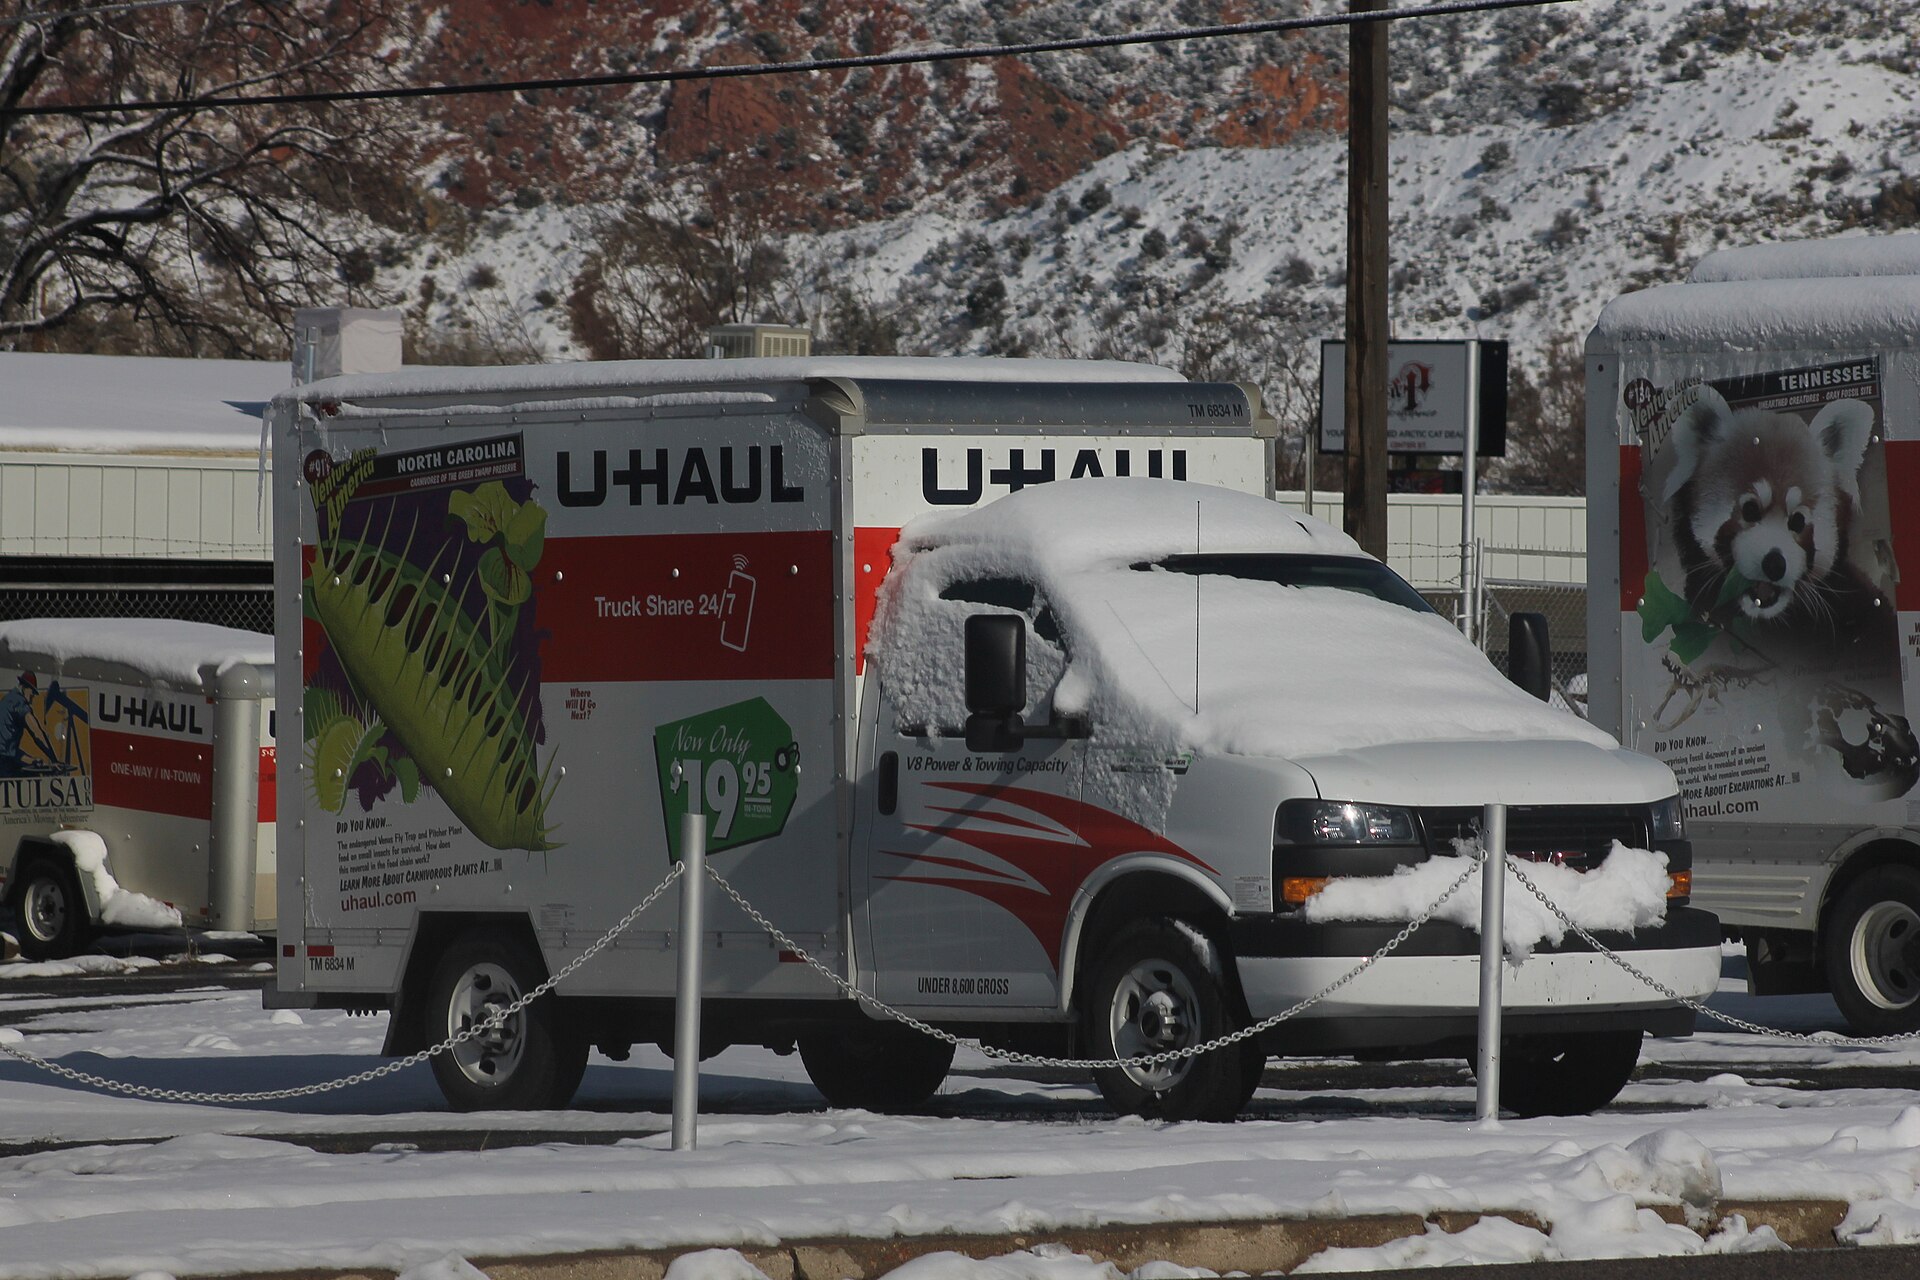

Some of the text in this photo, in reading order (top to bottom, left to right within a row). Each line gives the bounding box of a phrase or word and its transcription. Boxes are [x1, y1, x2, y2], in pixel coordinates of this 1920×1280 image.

[1779, 365, 1871, 391] TENNESSEE
[1789, 393, 1820, 406] CREATURES
[1826, 390, 1840, 400] GRAY
[1841, 388, 1859, 399] FOSSIL
[1861, 386, 1872, 396] SITE
[1188, 404, 1243, 418] TM 6834 M
[1630, 387, 1673, 434] Venture
[1399, 430, 1426, 439] ARCTIC
[1428, 430, 1442, 438] CAT
[1648, 386, 1699, 464] America
[397, 440, 516, 473] NORTH CAROLINA
[310, 459, 351, 511] Venture
[410, 462, 517, 488] CARNIVORES OF THE GREEN SWAMP PRESERVE
[557, 445, 804, 507] U-HAUL
[327, 459, 375, 541] America
[594, 589, 736, 618] Truck Share 24/7
[570, 688, 591, 698] Where
[99, 692, 203, 735] U-HAUL
[565, 699, 596, 711] Will U Go
[571, 710, 591, 720] Next?
[671, 724, 751, 764] Now Only
[1690, 752, 1703, 762] fossil
[1705, 751, 1729, 760] discovery
[1731, 747, 1737, 756] of
[1746, 743, 1765, 753] ancient
[110, 762, 152, 778] ONE-WAY
[160, 769, 200, 784] IN-TOWN
[906, 756, 1068, 775] V8 Power & Towing Capacity
[1688, 764, 1706, 774] species
[1708, 762, 1712, 770] is
[1714, 759, 1736, 769] revealed
[1744, 755, 1756, 765] only
[1702, 772, 1717, 782] What
[1719, 770, 1739, 779] remains
[1740, 763, 1770, 776] uncovered?
[0, 777, 82, 808] TULSA
[744, 804, 772, 813] IN-TOWN
[337, 826, 462, 850] The endangered Venus Fly Trap and Pitcher Plant
[358, 849, 372, 859] small
[373, 848, 390, 857] insects
[392, 845, 400, 855] for
[401, 843, 422, 853] survival.
[426, 841, 437, 850] How
[439, 840, 450, 849] does
[339, 865, 348, 874] this
[371, 861, 376, 870] in
[377, 860, 385, 869] the
[387, 858, 398, 868] food
[400, 857, 413, 867] chain
[415, 853, 430, 865] work?
[341, 890, 416, 912] uhaul.com
[309, 957, 355, 971] TM 6834 M
[918, 977, 1009, 995] UNDER 8,600 GROSS
